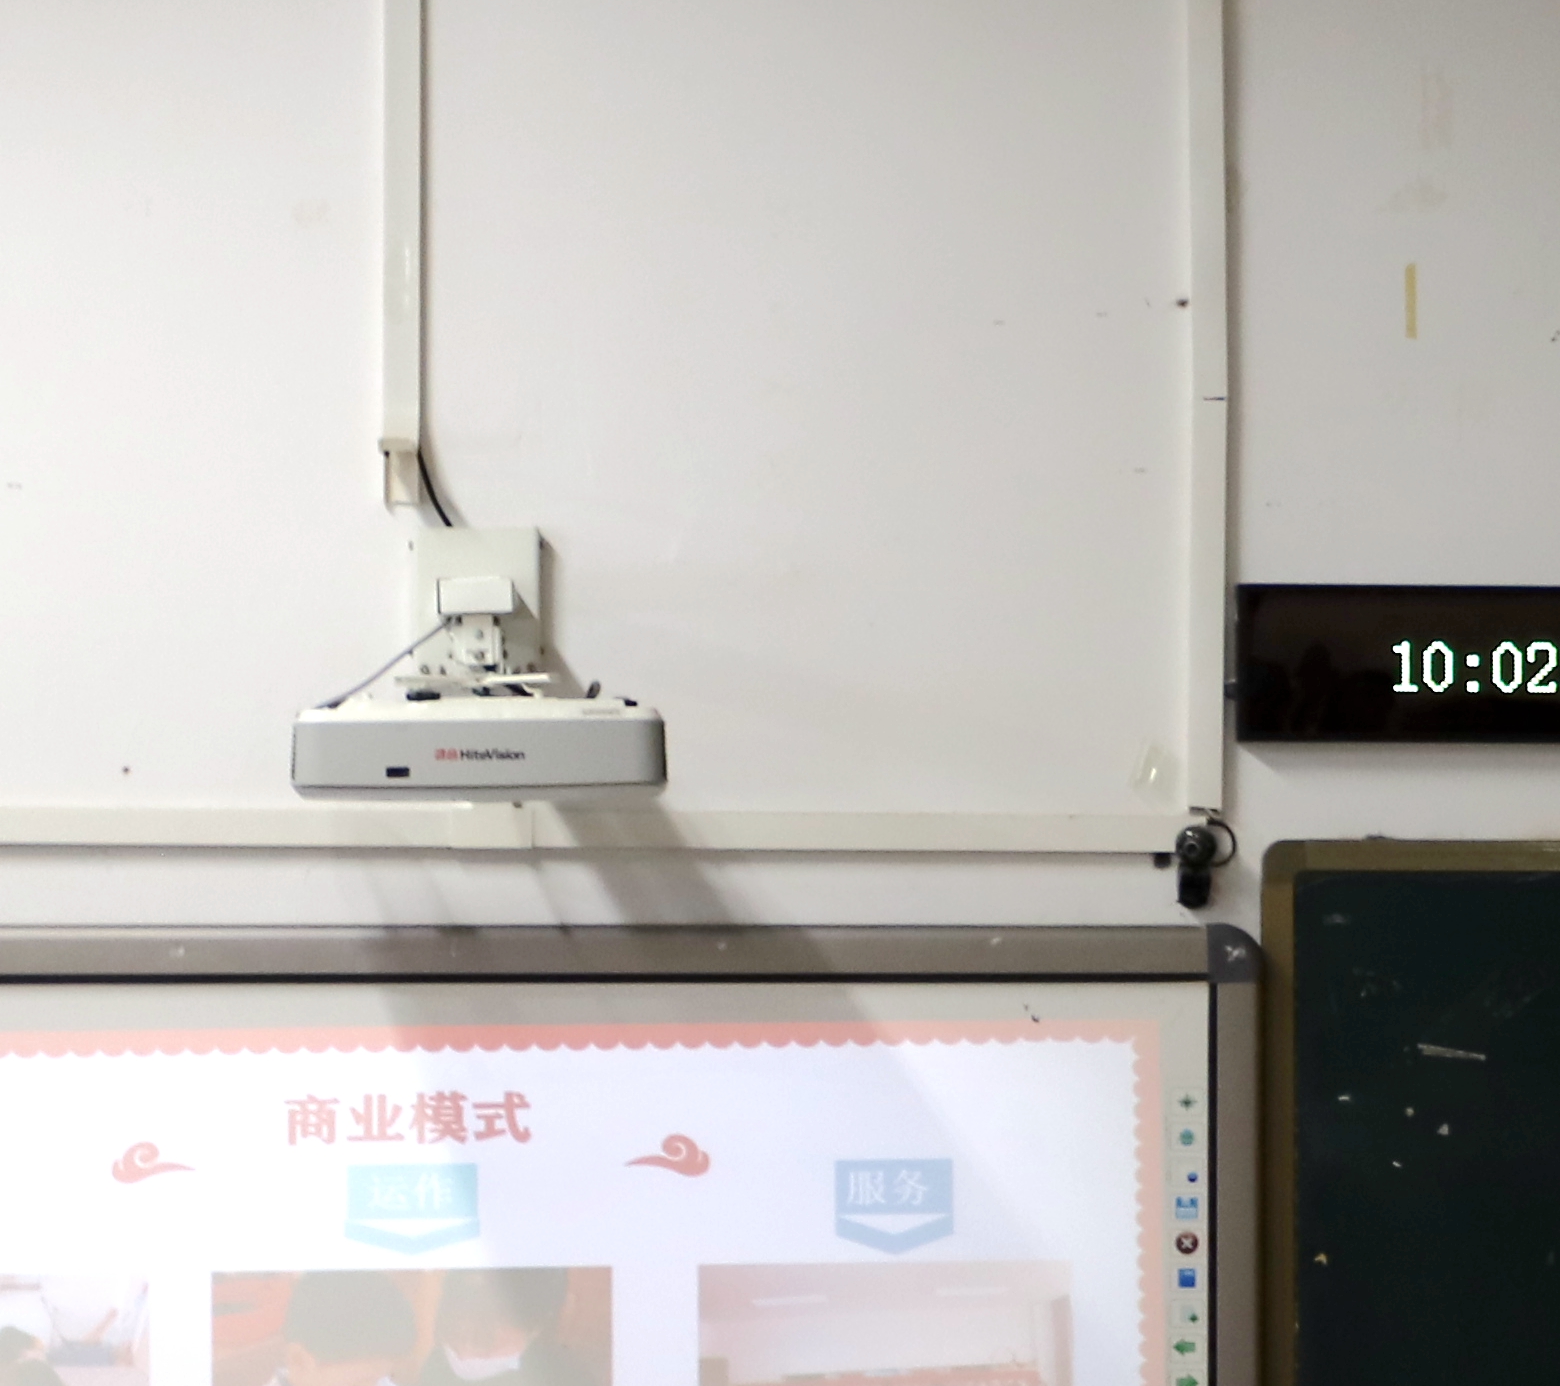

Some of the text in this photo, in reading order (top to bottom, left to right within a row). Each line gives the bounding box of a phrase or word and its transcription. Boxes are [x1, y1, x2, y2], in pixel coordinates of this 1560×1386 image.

[284, 1090, 532, 1145] 商业模式
[847, 1170, 929, 1206] 服务
